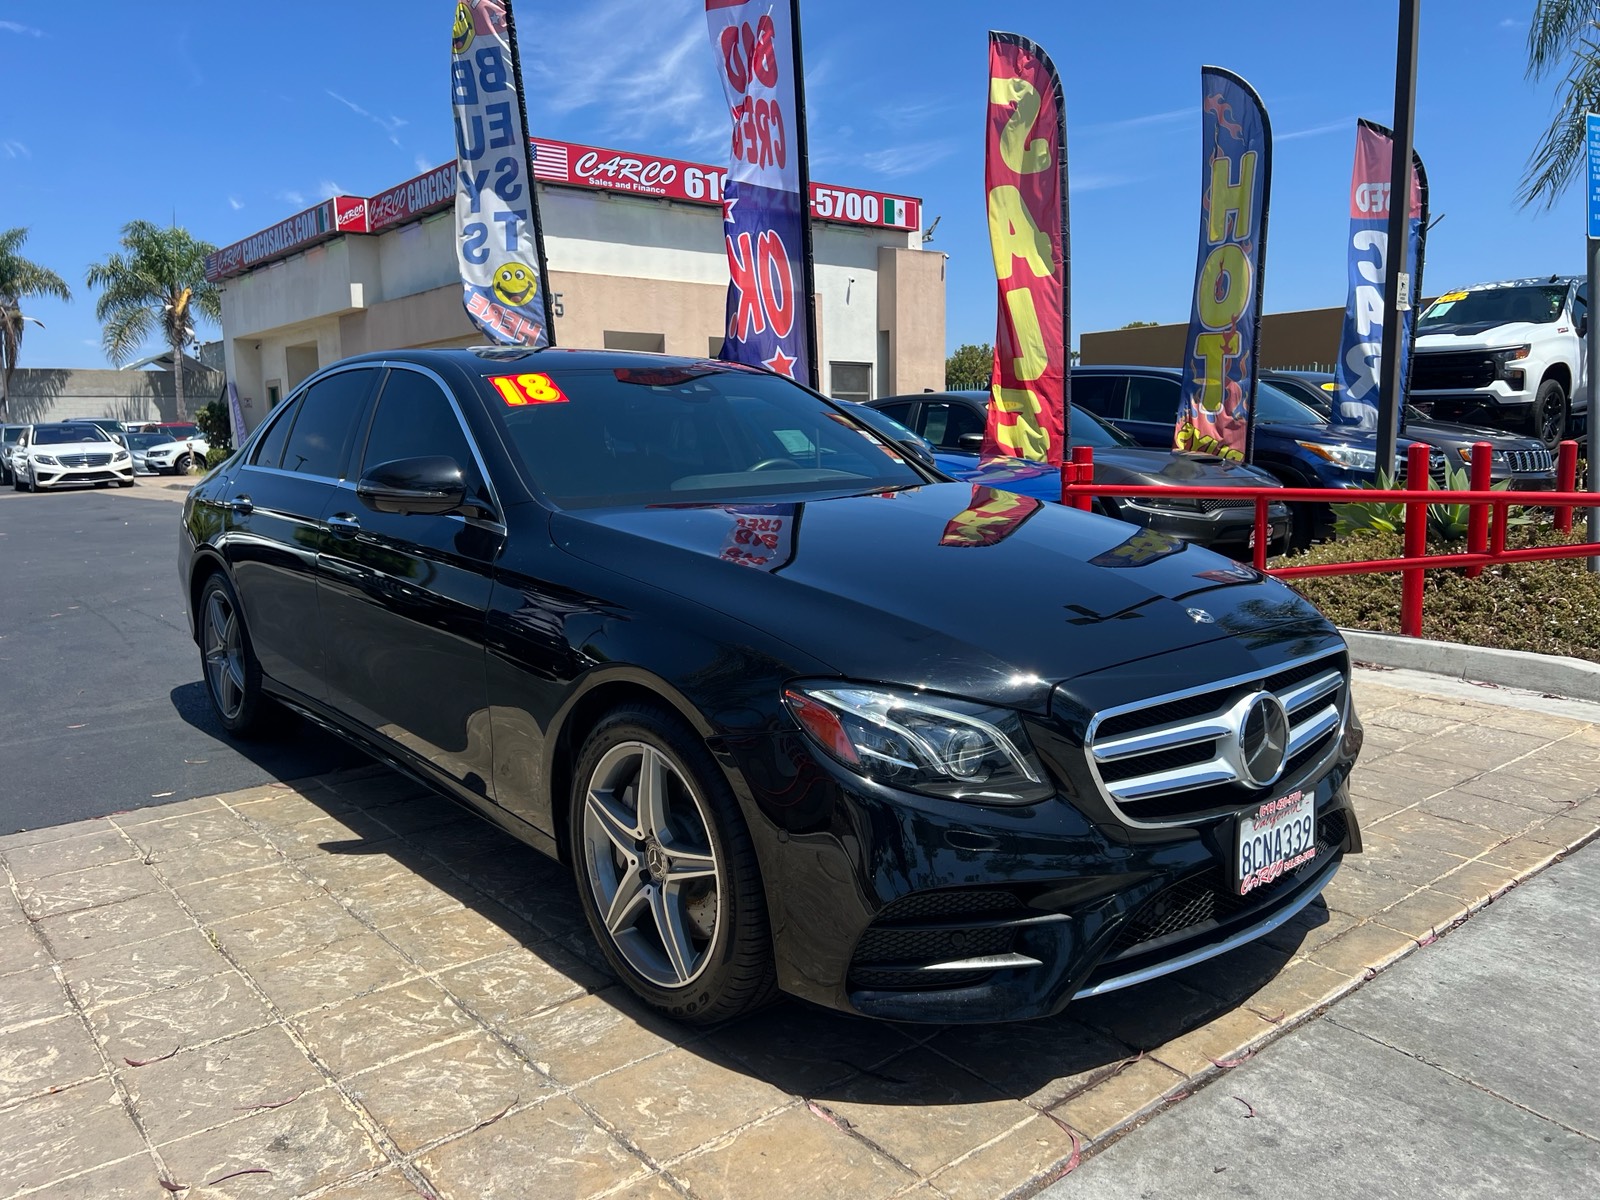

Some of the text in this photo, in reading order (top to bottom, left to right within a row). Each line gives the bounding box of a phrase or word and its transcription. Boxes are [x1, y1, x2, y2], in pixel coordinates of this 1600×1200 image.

[575, 152, 677, 186] CARCO
[684, 167, 728, 201] 61
[589, 177, 666, 195] Sales and Finance
[337, 204, 364, 225] CARCO
[369, 187, 406, 224] CARCO
[242, 210, 318, 265] CARCOSALES.COM
[494, 374, 560, 405] 18
[1242, 815, 1311, 877] 8CNA339
[1241, 859, 1283, 896] CARCO
